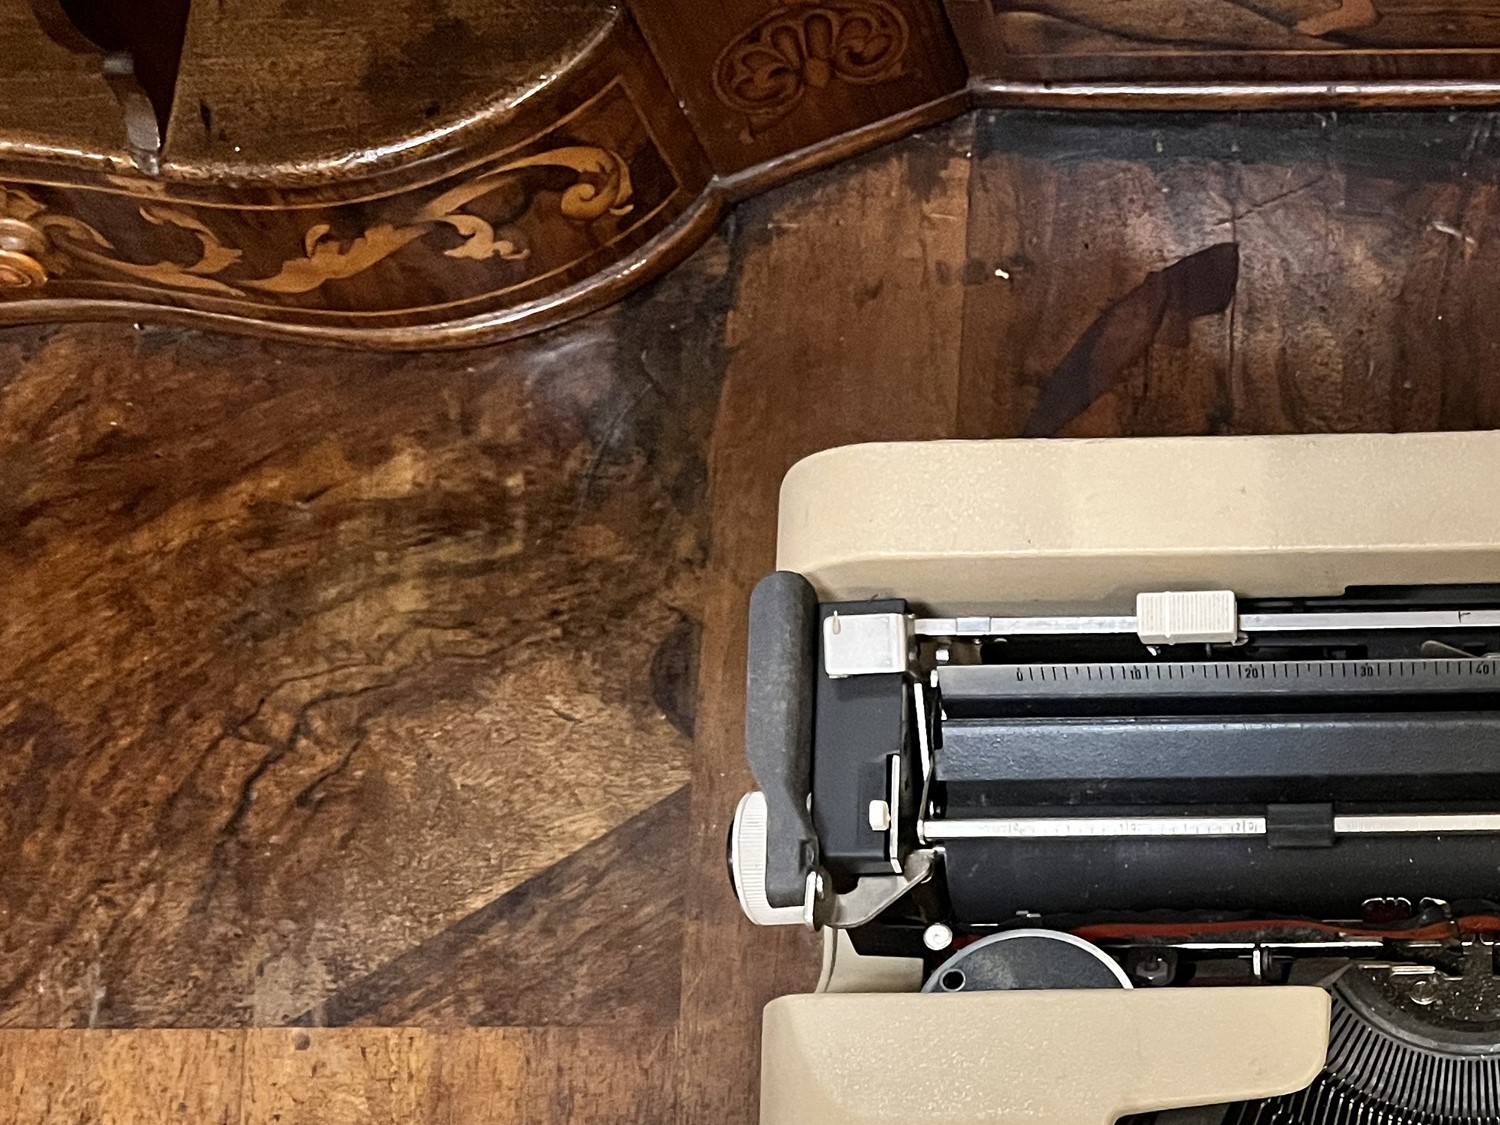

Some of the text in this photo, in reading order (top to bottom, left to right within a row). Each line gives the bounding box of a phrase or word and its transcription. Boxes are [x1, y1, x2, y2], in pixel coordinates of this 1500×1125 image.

[1244, 667, 1259, 679] 20
[1360, 665, 1374, 678] 30
[1475, 664, 1490, 675] 40
